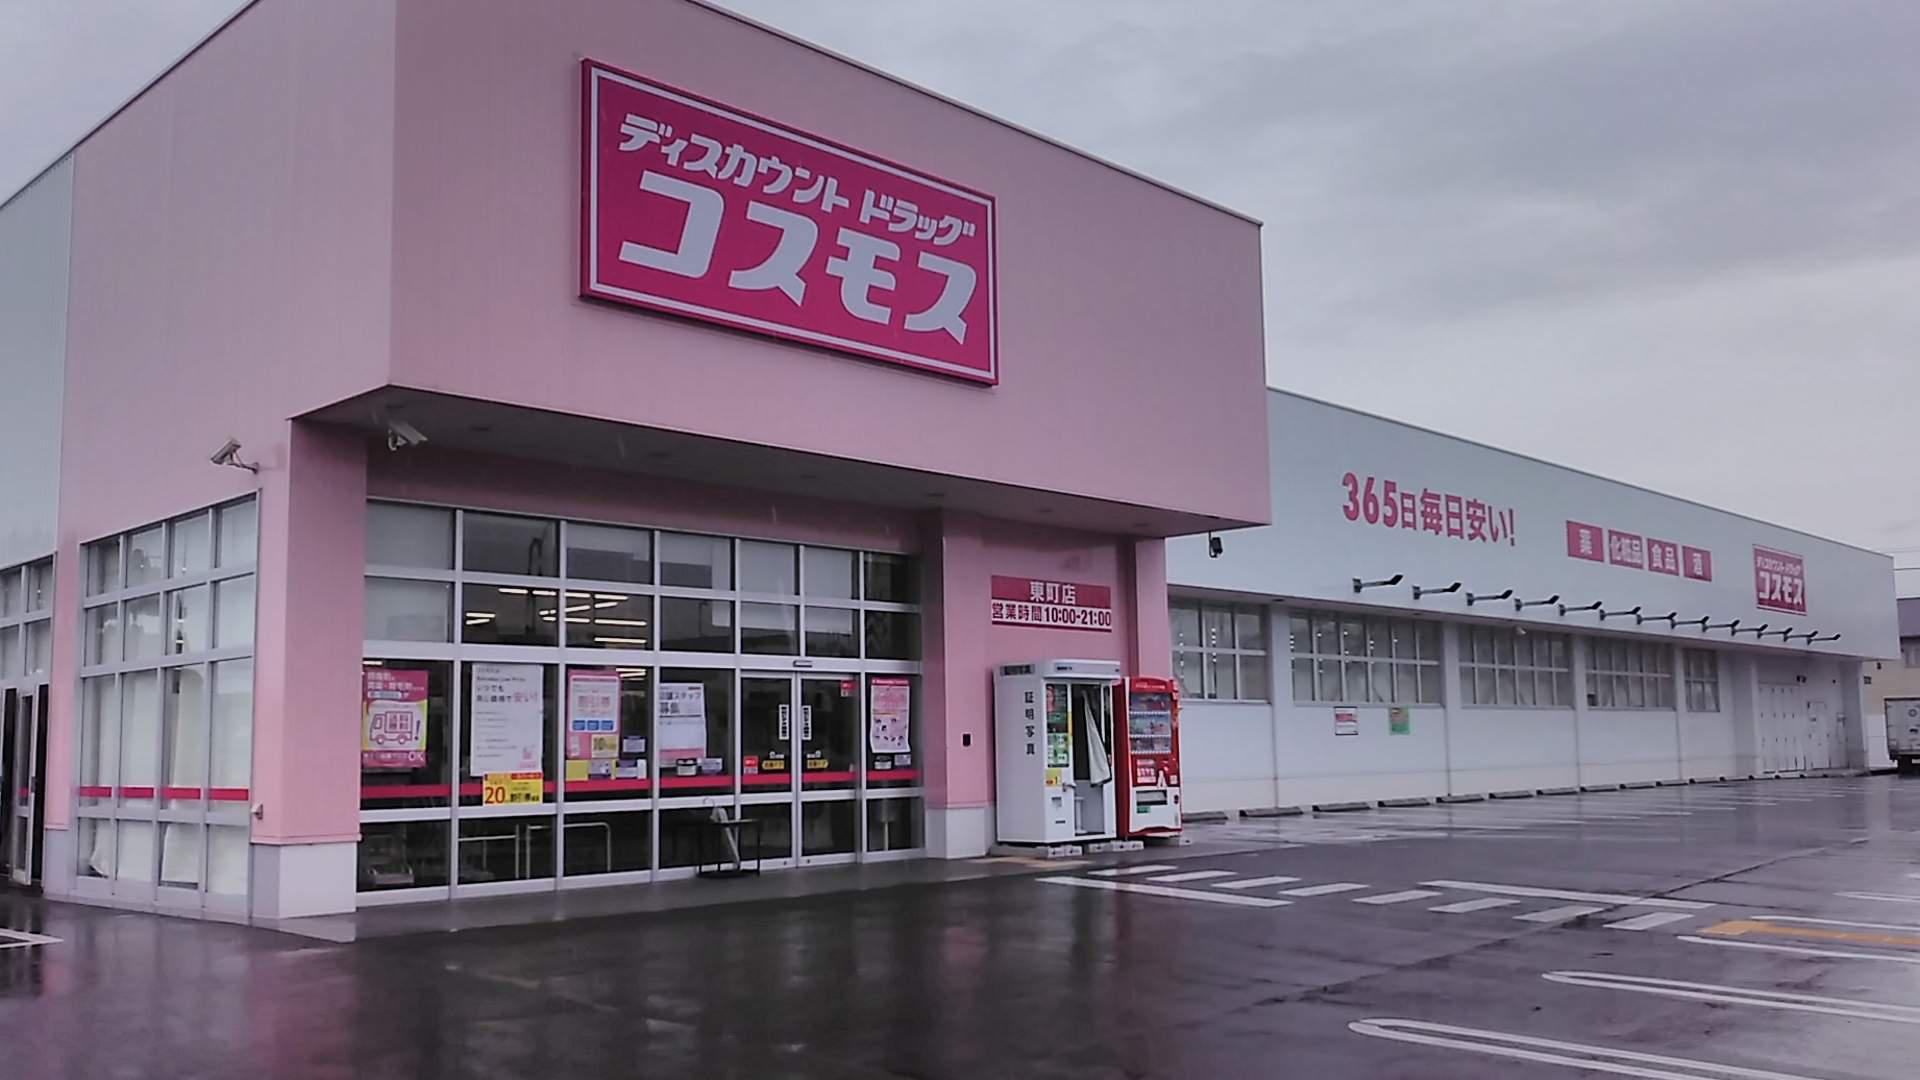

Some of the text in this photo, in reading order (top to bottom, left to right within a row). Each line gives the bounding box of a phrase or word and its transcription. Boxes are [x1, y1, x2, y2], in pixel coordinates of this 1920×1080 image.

[619, 113, 976, 245] ディスカウント ドラッグ
[619, 170, 977, 345] コスモス
[1652, 544, 1676, 570] 食品
[1030, 581, 1076, 605] 東町店
[1759, 570, 1802, 605] コスモス
[485, 786, 505, 804] 20
